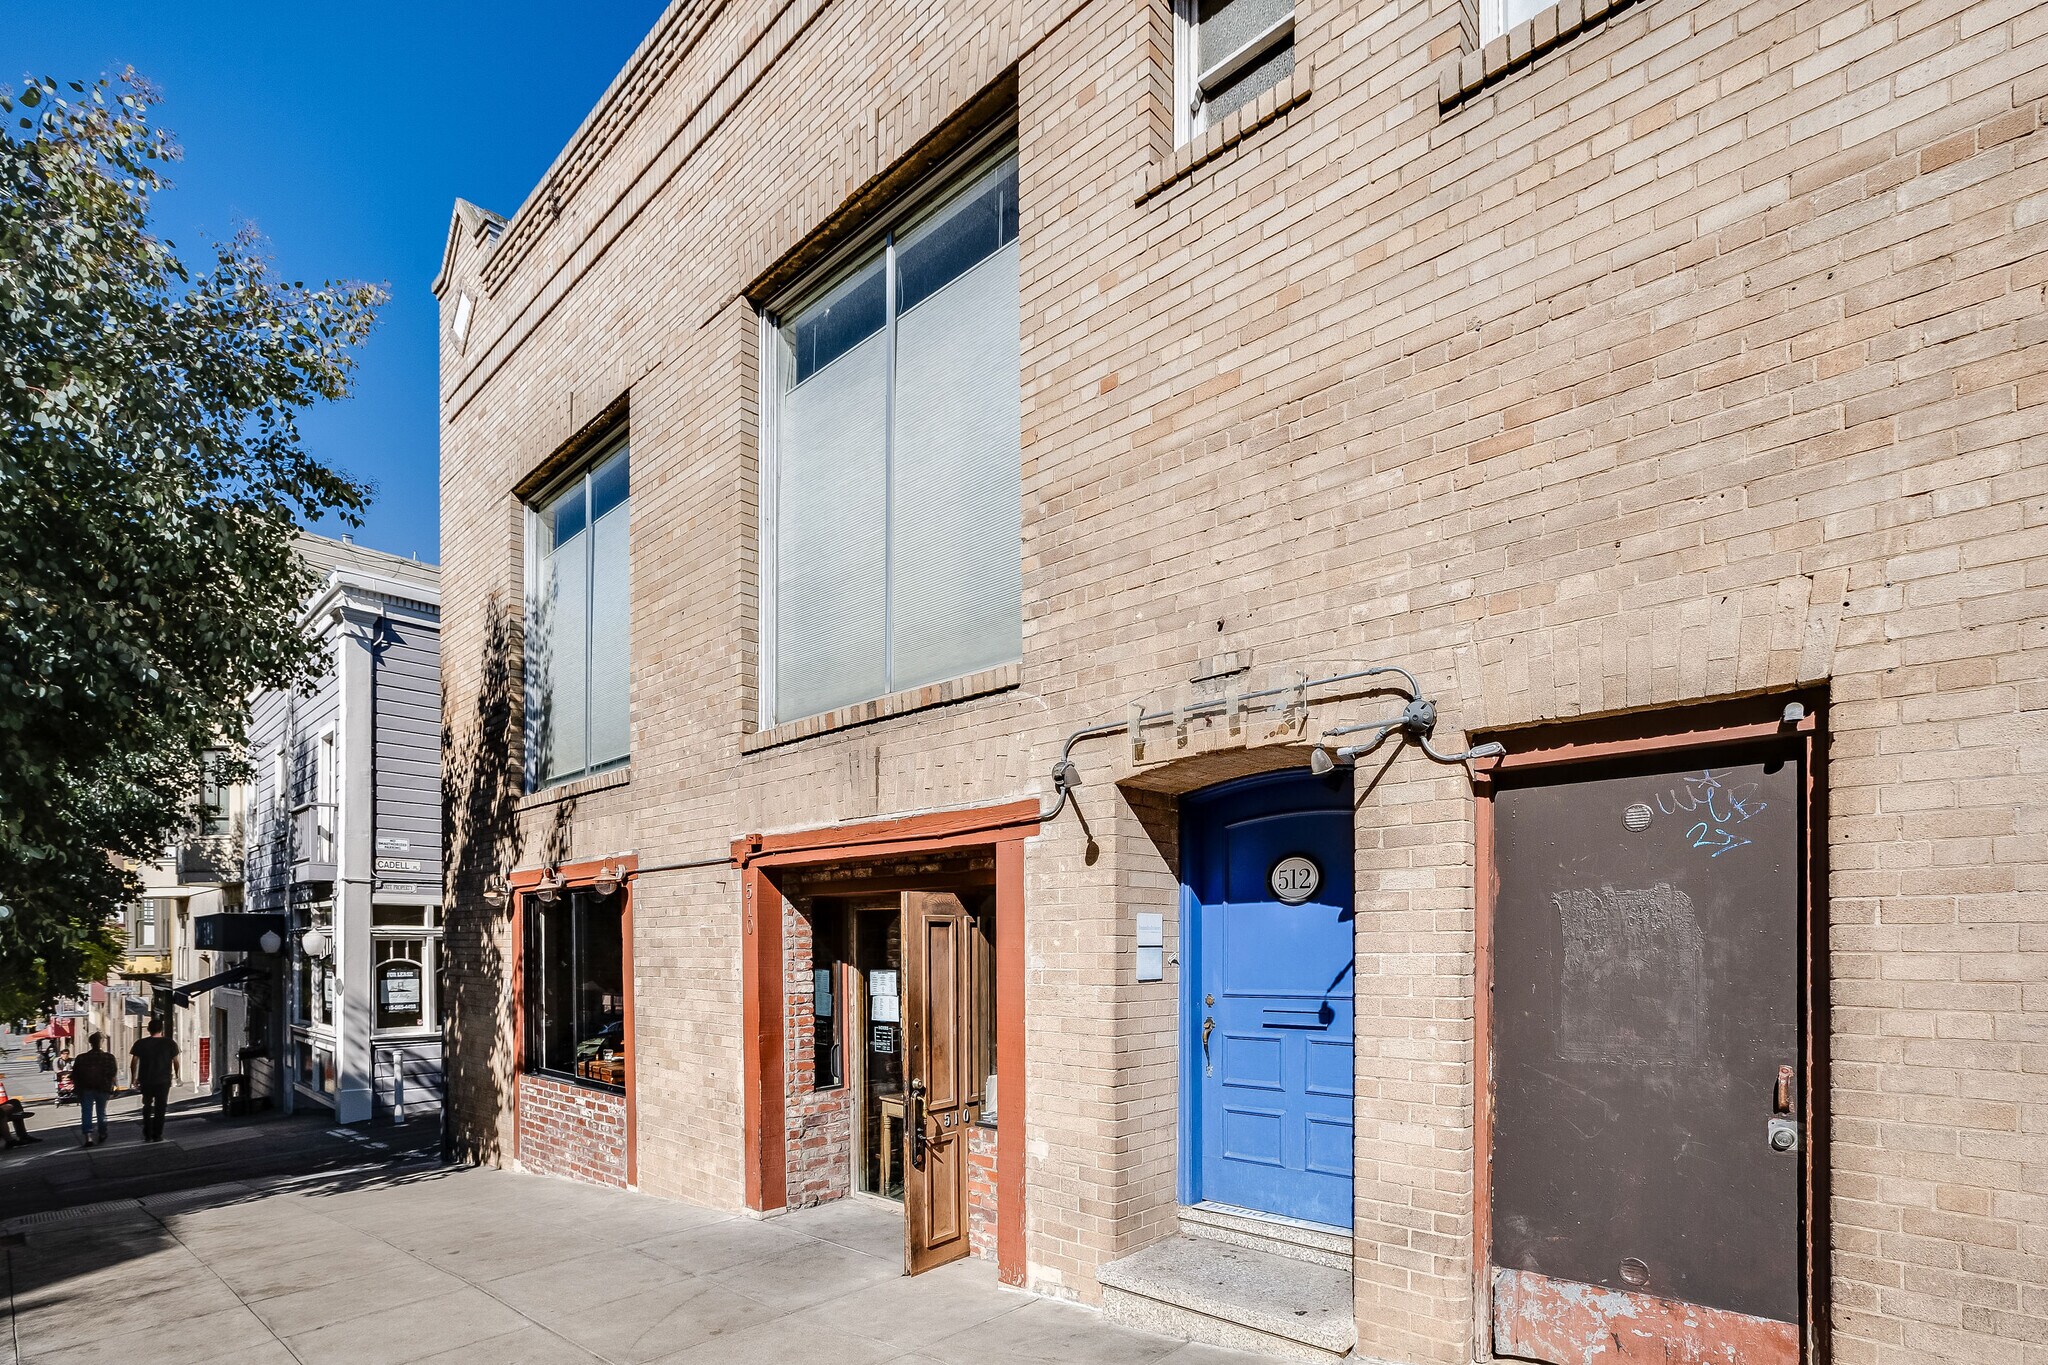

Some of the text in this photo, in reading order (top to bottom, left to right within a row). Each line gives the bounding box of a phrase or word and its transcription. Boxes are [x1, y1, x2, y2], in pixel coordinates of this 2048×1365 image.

[378, 860, 410, 869] CADELL
[1279, 868, 1311, 890] 512
[944, 1108, 970, 1127] 510
